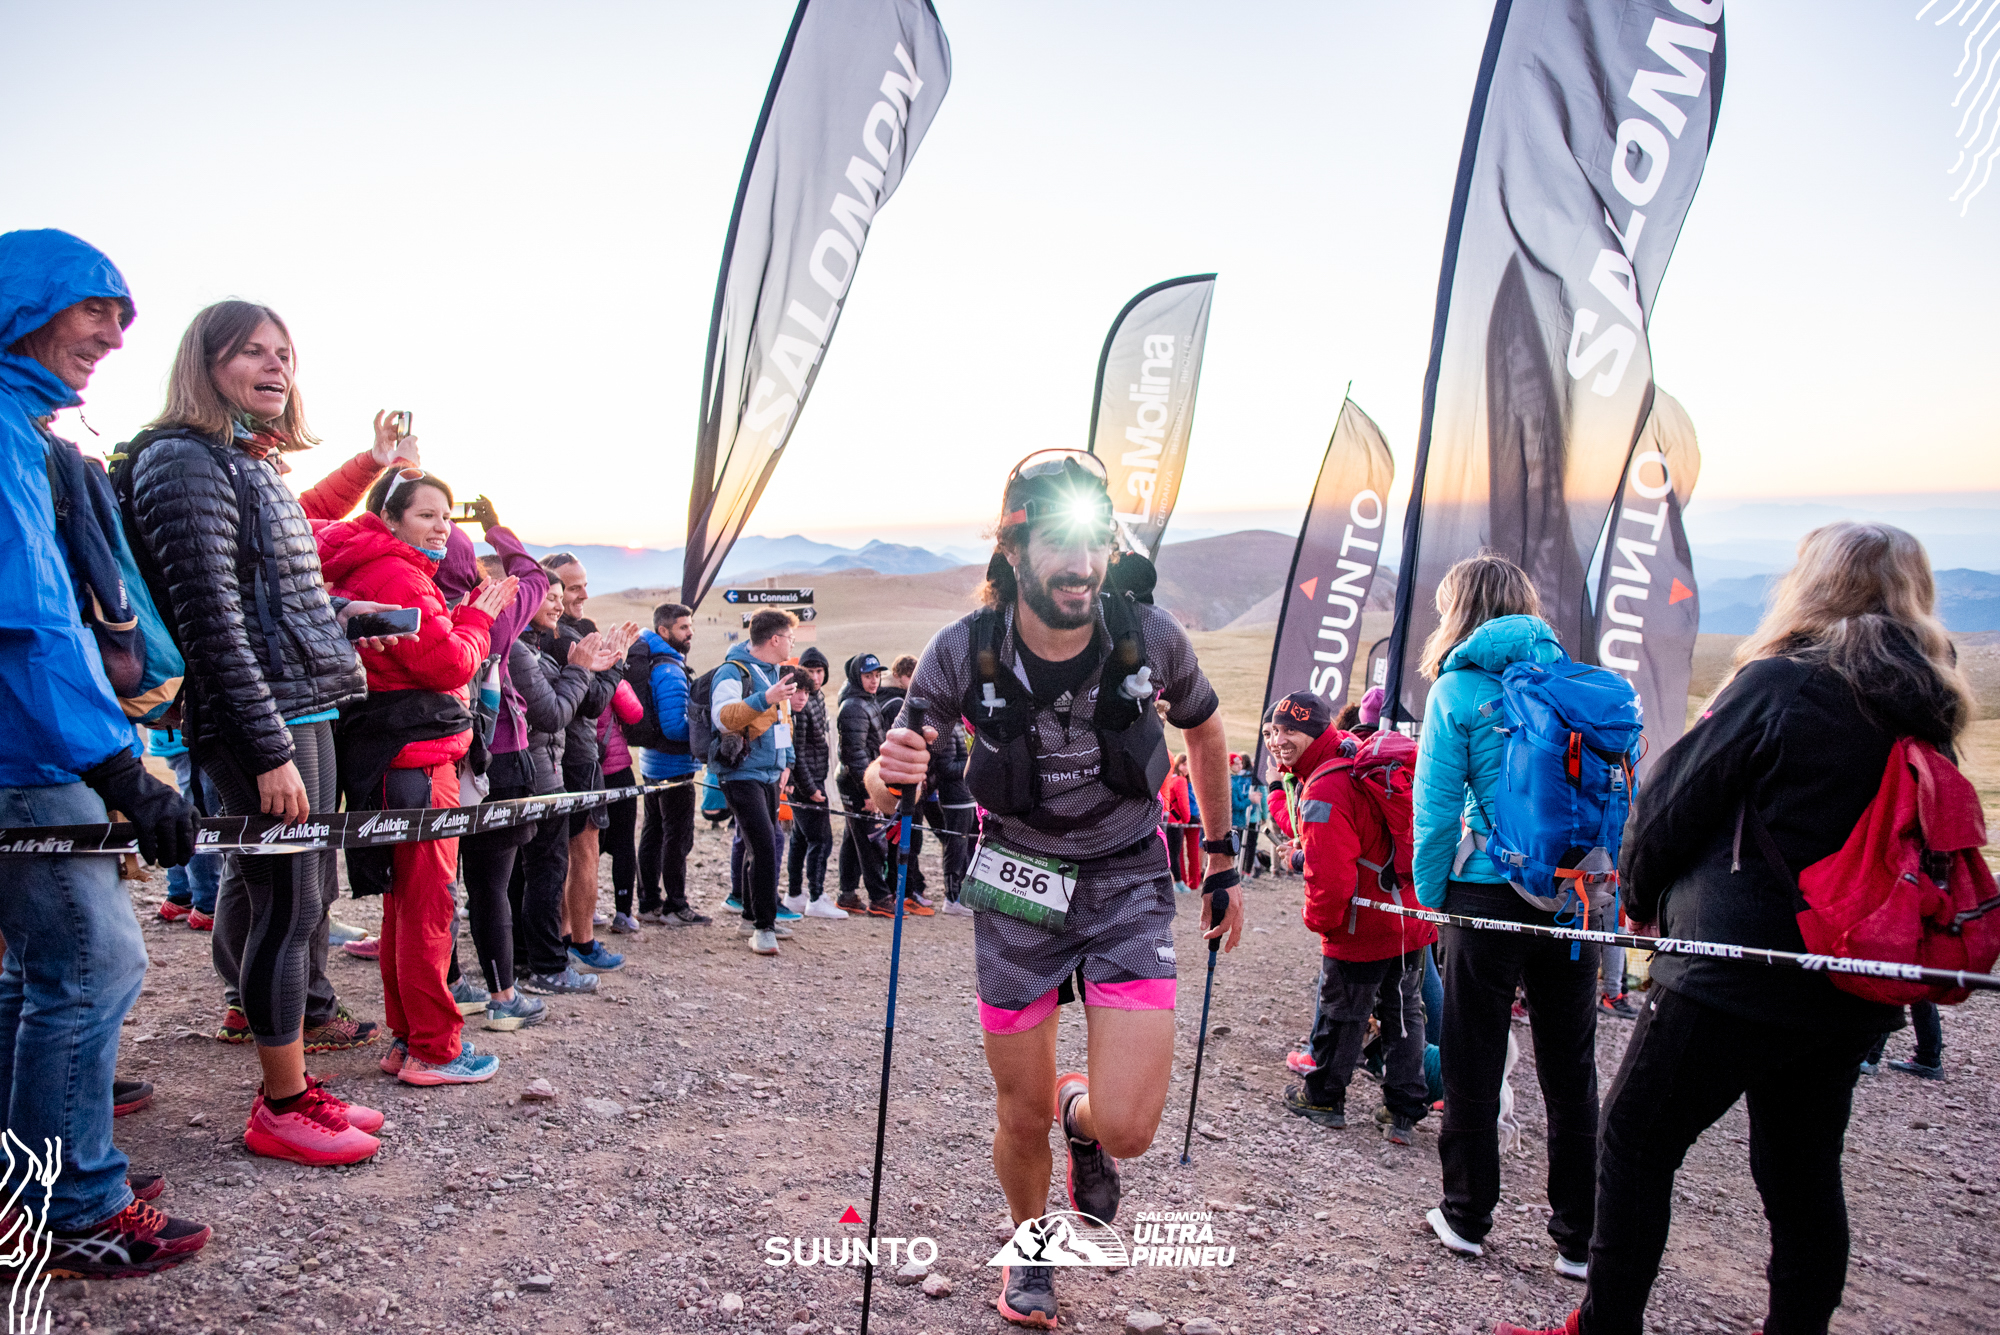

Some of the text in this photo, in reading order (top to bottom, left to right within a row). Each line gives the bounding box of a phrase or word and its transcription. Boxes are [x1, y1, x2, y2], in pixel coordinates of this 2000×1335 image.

[1566, 0, 1724, 398] SALOM
[744, 40, 925, 450] SALOMON
[1156, 470, 1174, 528] CERDANYA
[748, 592, 799, 602] La Connexió
[1309, 489, 1383, 702] SUUNTO
[1038, 770, 1082, 782] TISME
[999, 861, 1051, 895] 856
[1034, 856, 1049, 868] 2023
[1011, 886, 1028, 897] Arni
